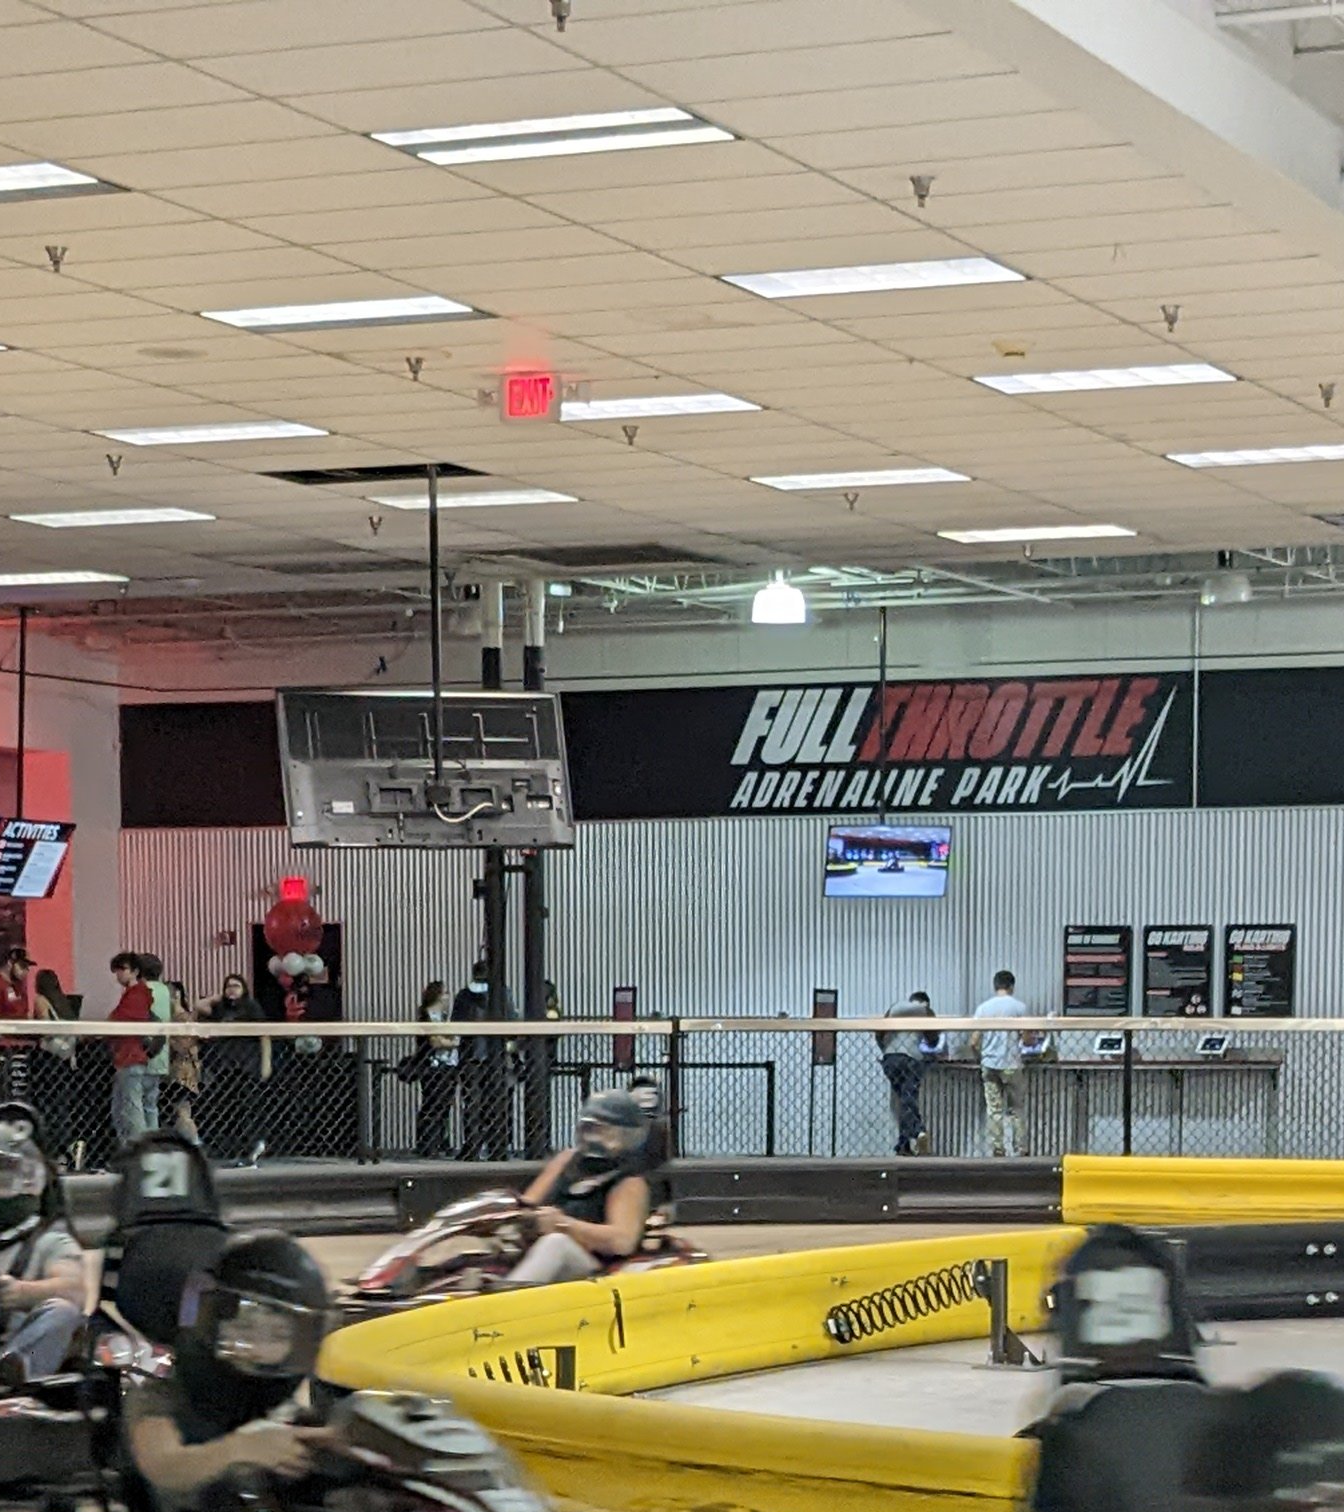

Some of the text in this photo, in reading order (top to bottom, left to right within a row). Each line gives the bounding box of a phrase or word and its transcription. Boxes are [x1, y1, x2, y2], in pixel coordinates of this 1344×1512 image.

[508, 377, 551, 417] EXIT
[730, 678, 1160, 765] FULL THROTTLE
[730, 764, 1055, 808] ADRENALINE PARK
[2, 821, 61, 841] ACTIVITIES
